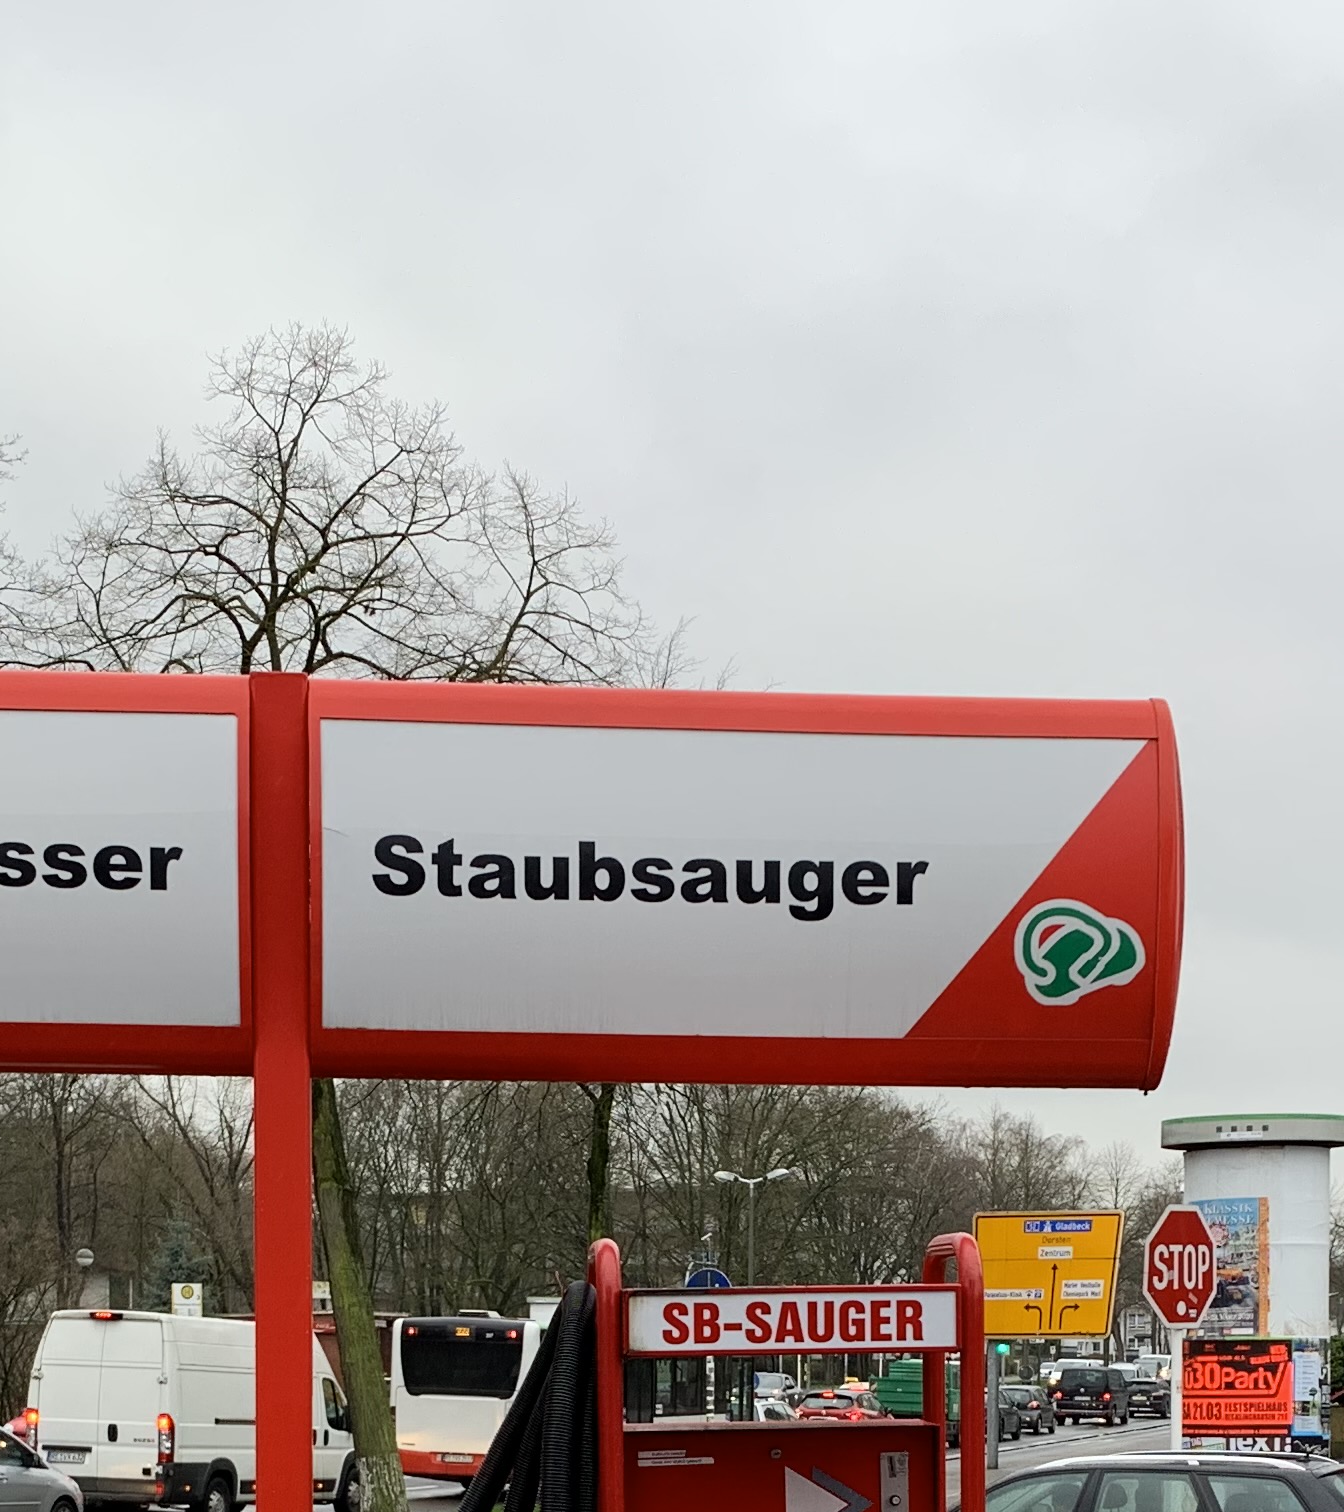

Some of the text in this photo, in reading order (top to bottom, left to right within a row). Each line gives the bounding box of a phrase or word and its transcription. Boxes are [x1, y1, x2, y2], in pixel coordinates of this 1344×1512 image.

[371, 833, 930, 922] Staubsauger
[1055, 1221, 1092, 1231] Gladbeck
[1039, 1248, 1072, 1257] Zentrum
[1153, 1243, 1211, 1291] STOP
[662, 1299, 925, 1345] SB-SAUGER
